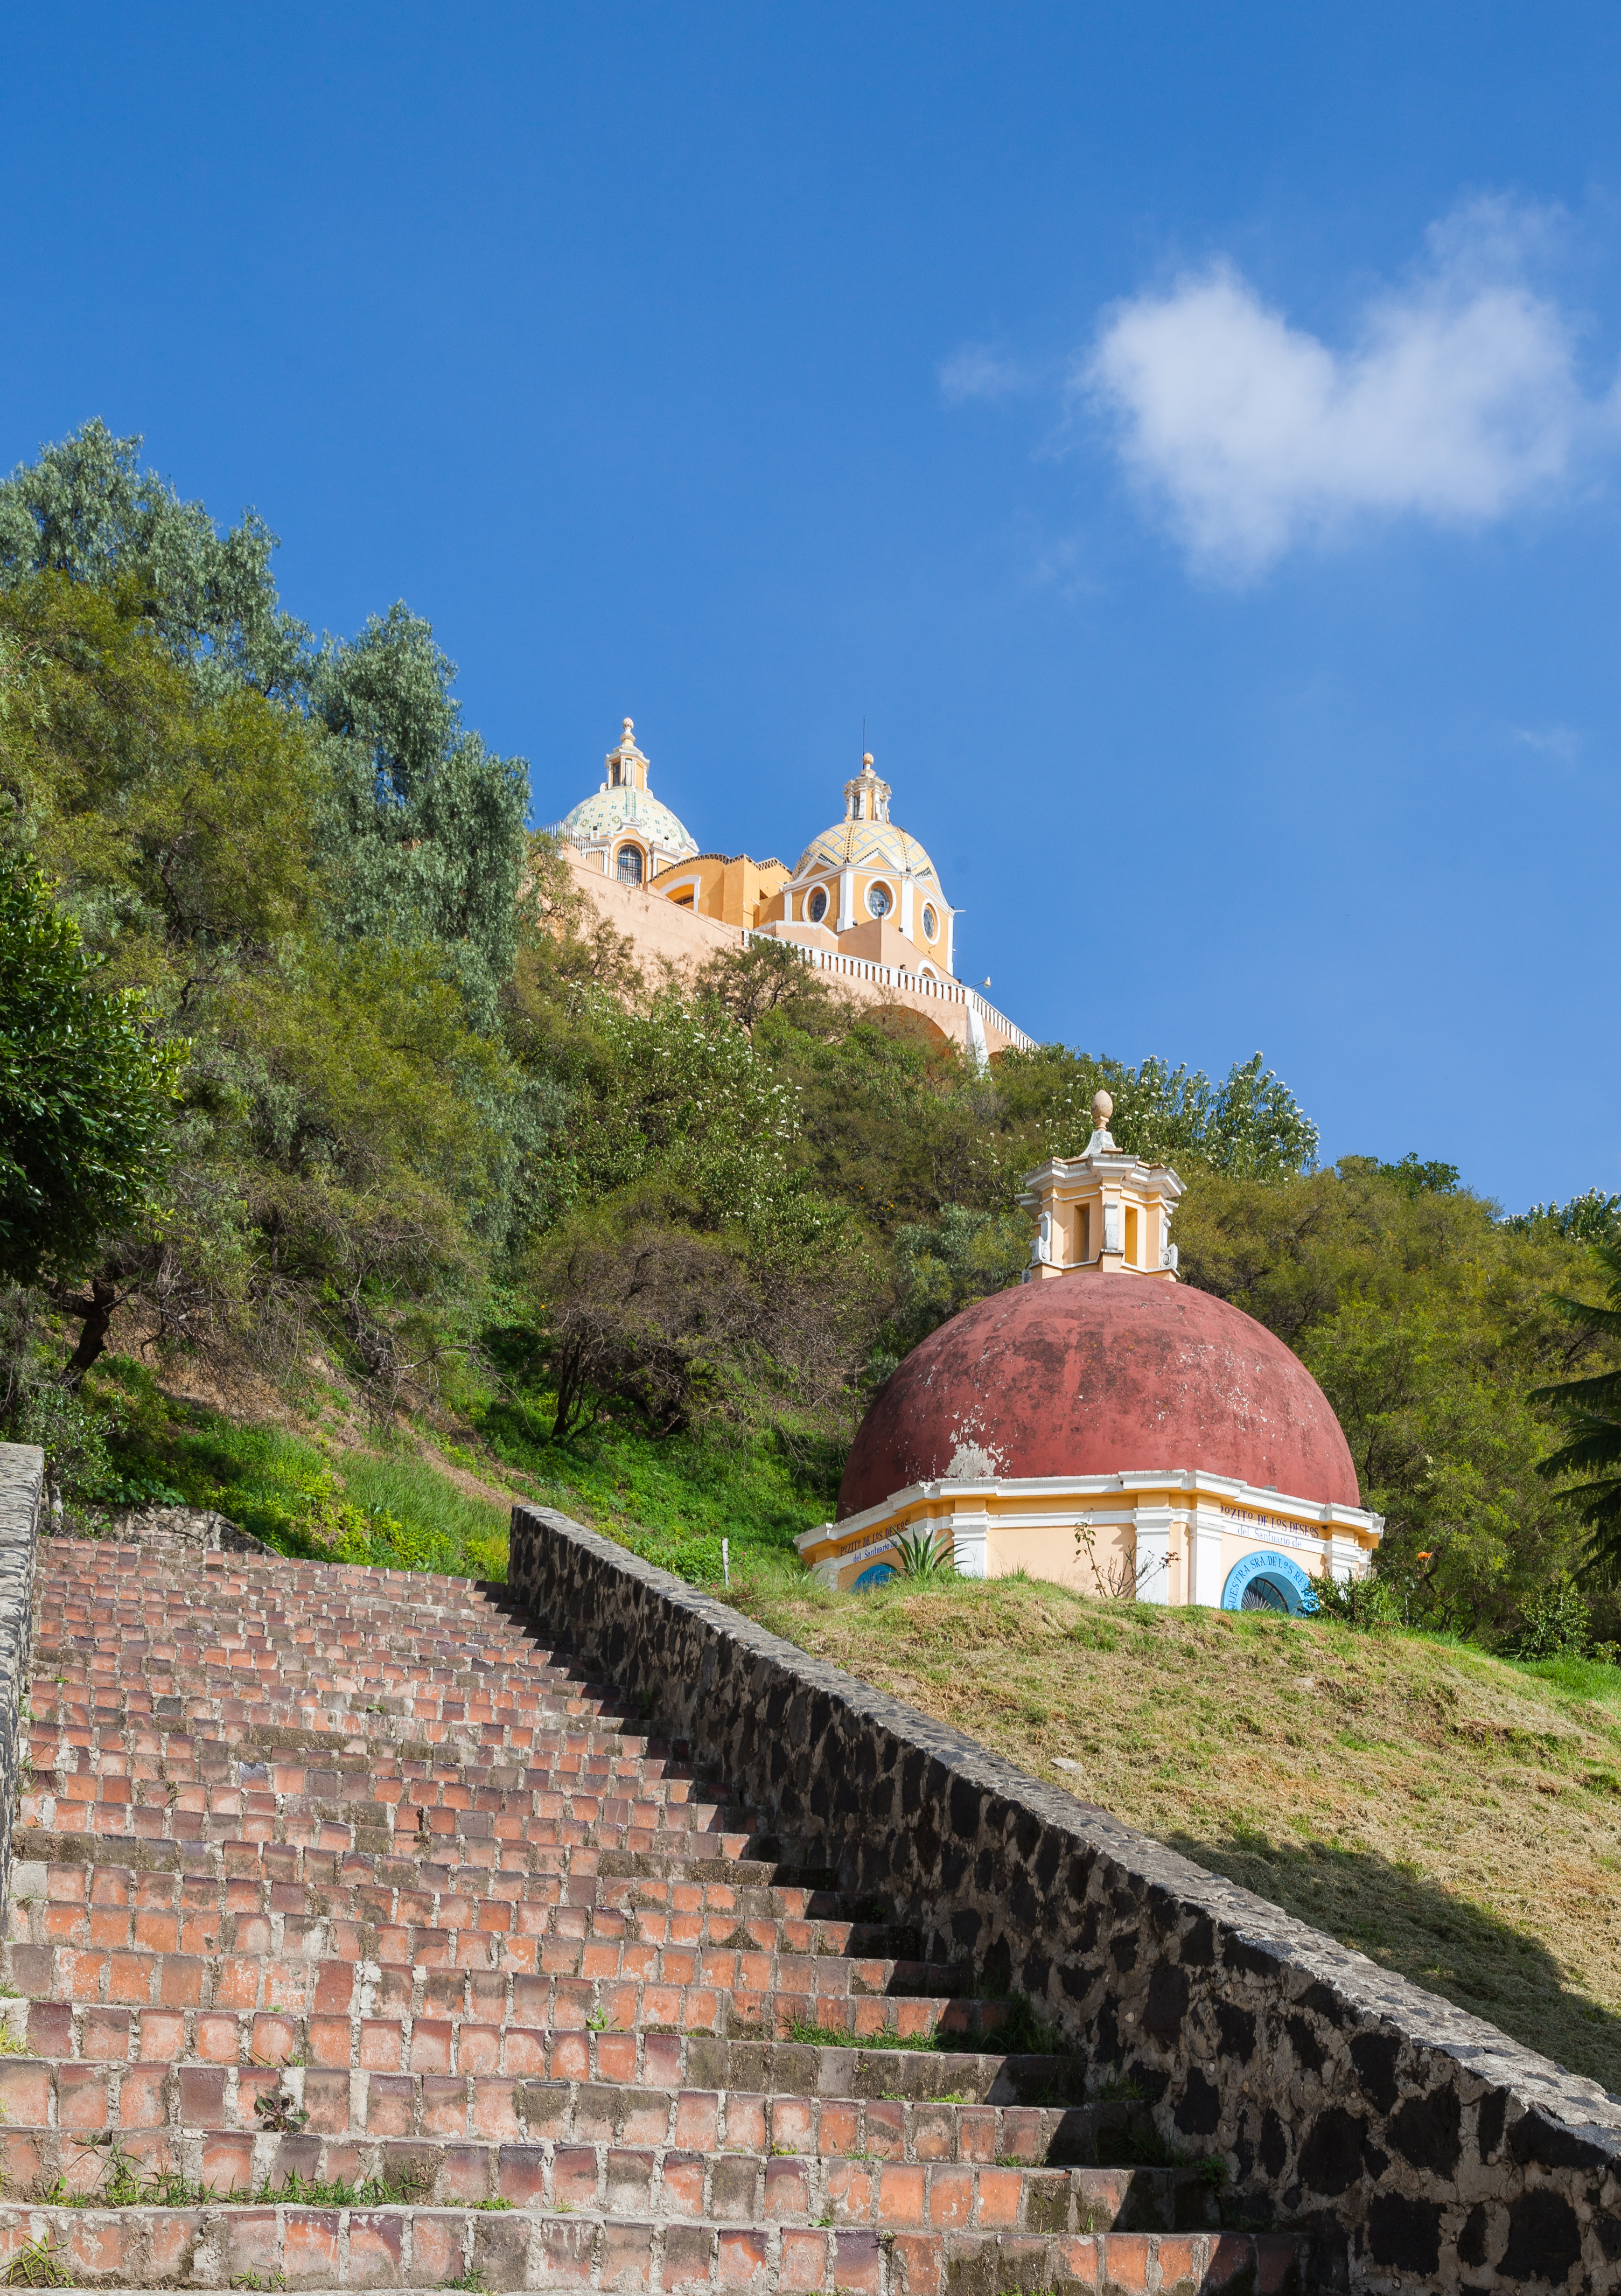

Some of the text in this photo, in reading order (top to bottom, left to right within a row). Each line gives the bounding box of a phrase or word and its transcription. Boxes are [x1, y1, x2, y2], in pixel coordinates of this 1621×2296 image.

[1238, 1525, 1302, 1548] del Santuario de
[1257, 1513, 1269, 1527] DE
[1271, 1517, 1287, 1531] LOS
[1289, 1521, 1319, 1539] DESEOS
[840, 1539, 861, 1556] POZITO
[863, 1535, 871, 1547] DE
[872, 1531, 883, 1544] LOS
[853, 1552, 861, 1563] del
[864, 1543, 890, 1559] Santuario
[1267, 1555, 1277, 1566] DE
[1278, 1558, 1294, 1574] LOS
